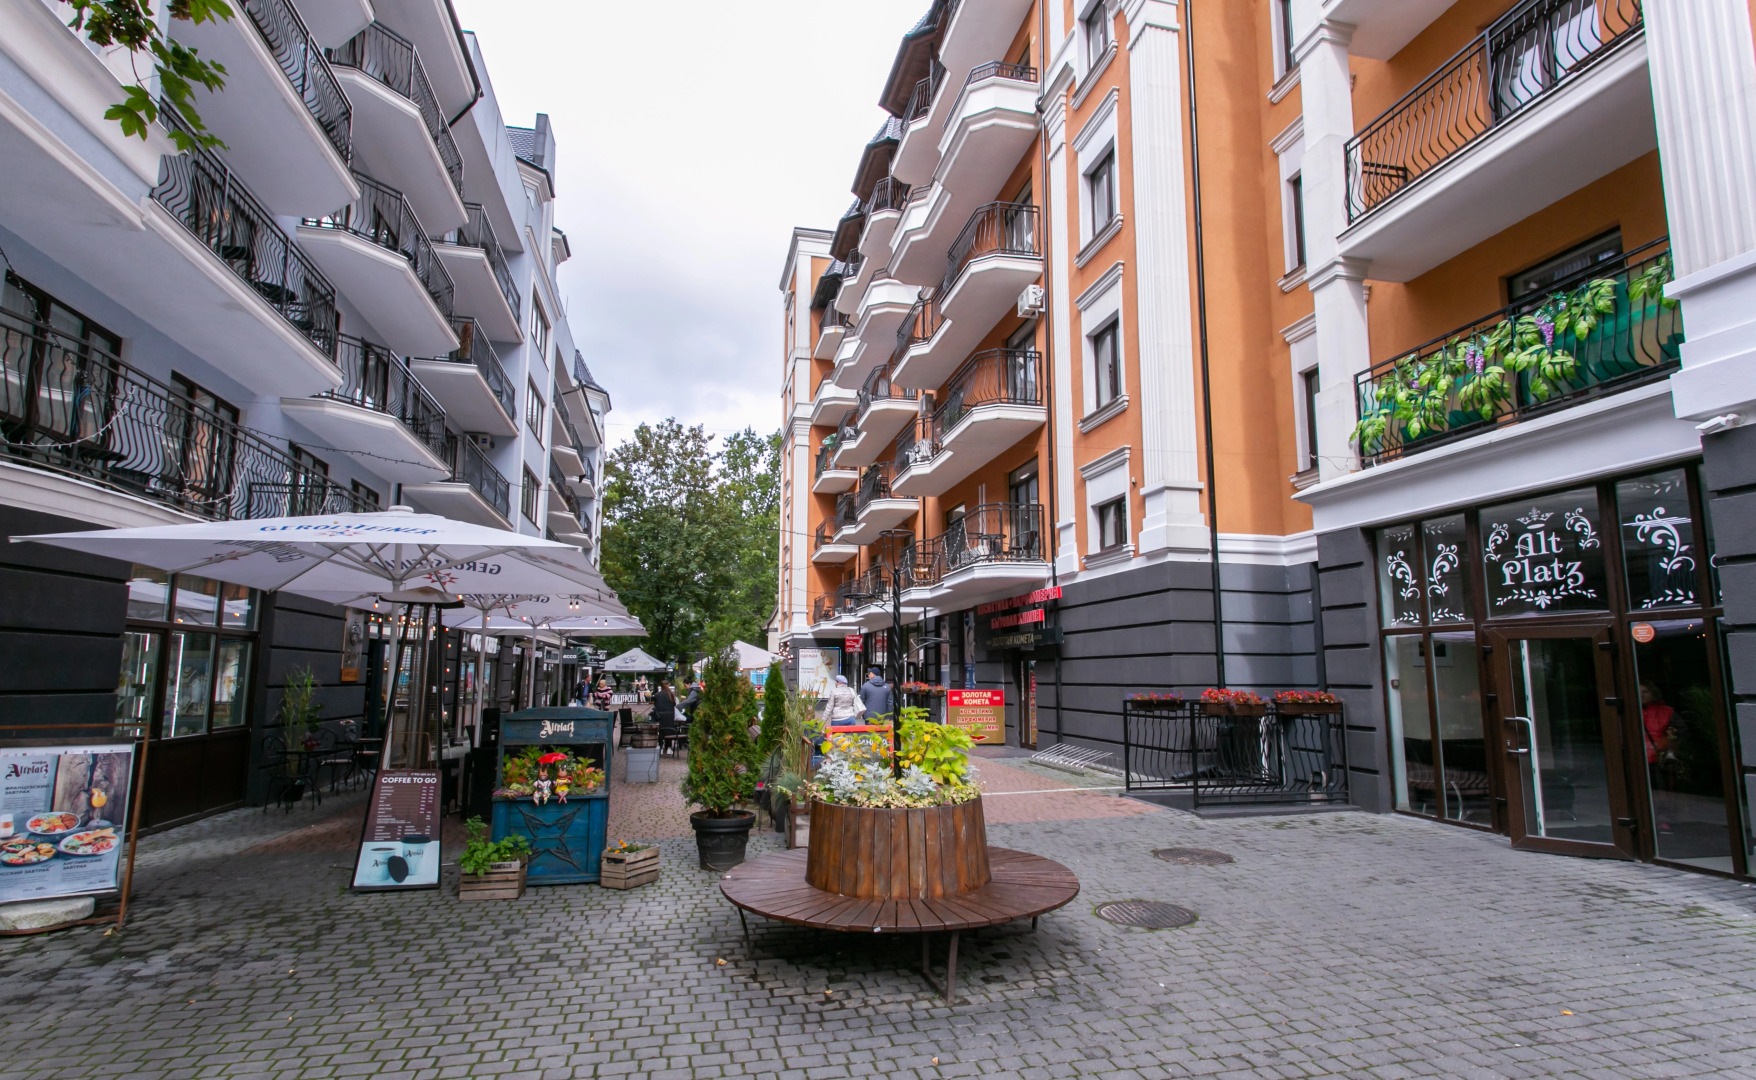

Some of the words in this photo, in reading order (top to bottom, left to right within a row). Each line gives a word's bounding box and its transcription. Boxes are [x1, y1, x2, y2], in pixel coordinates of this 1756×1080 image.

[1515, 530, 1563, 558] Alt
[1502, 558, 1584, 589] Platz
[1013, 633, 1034, 645] КОМЕТА
